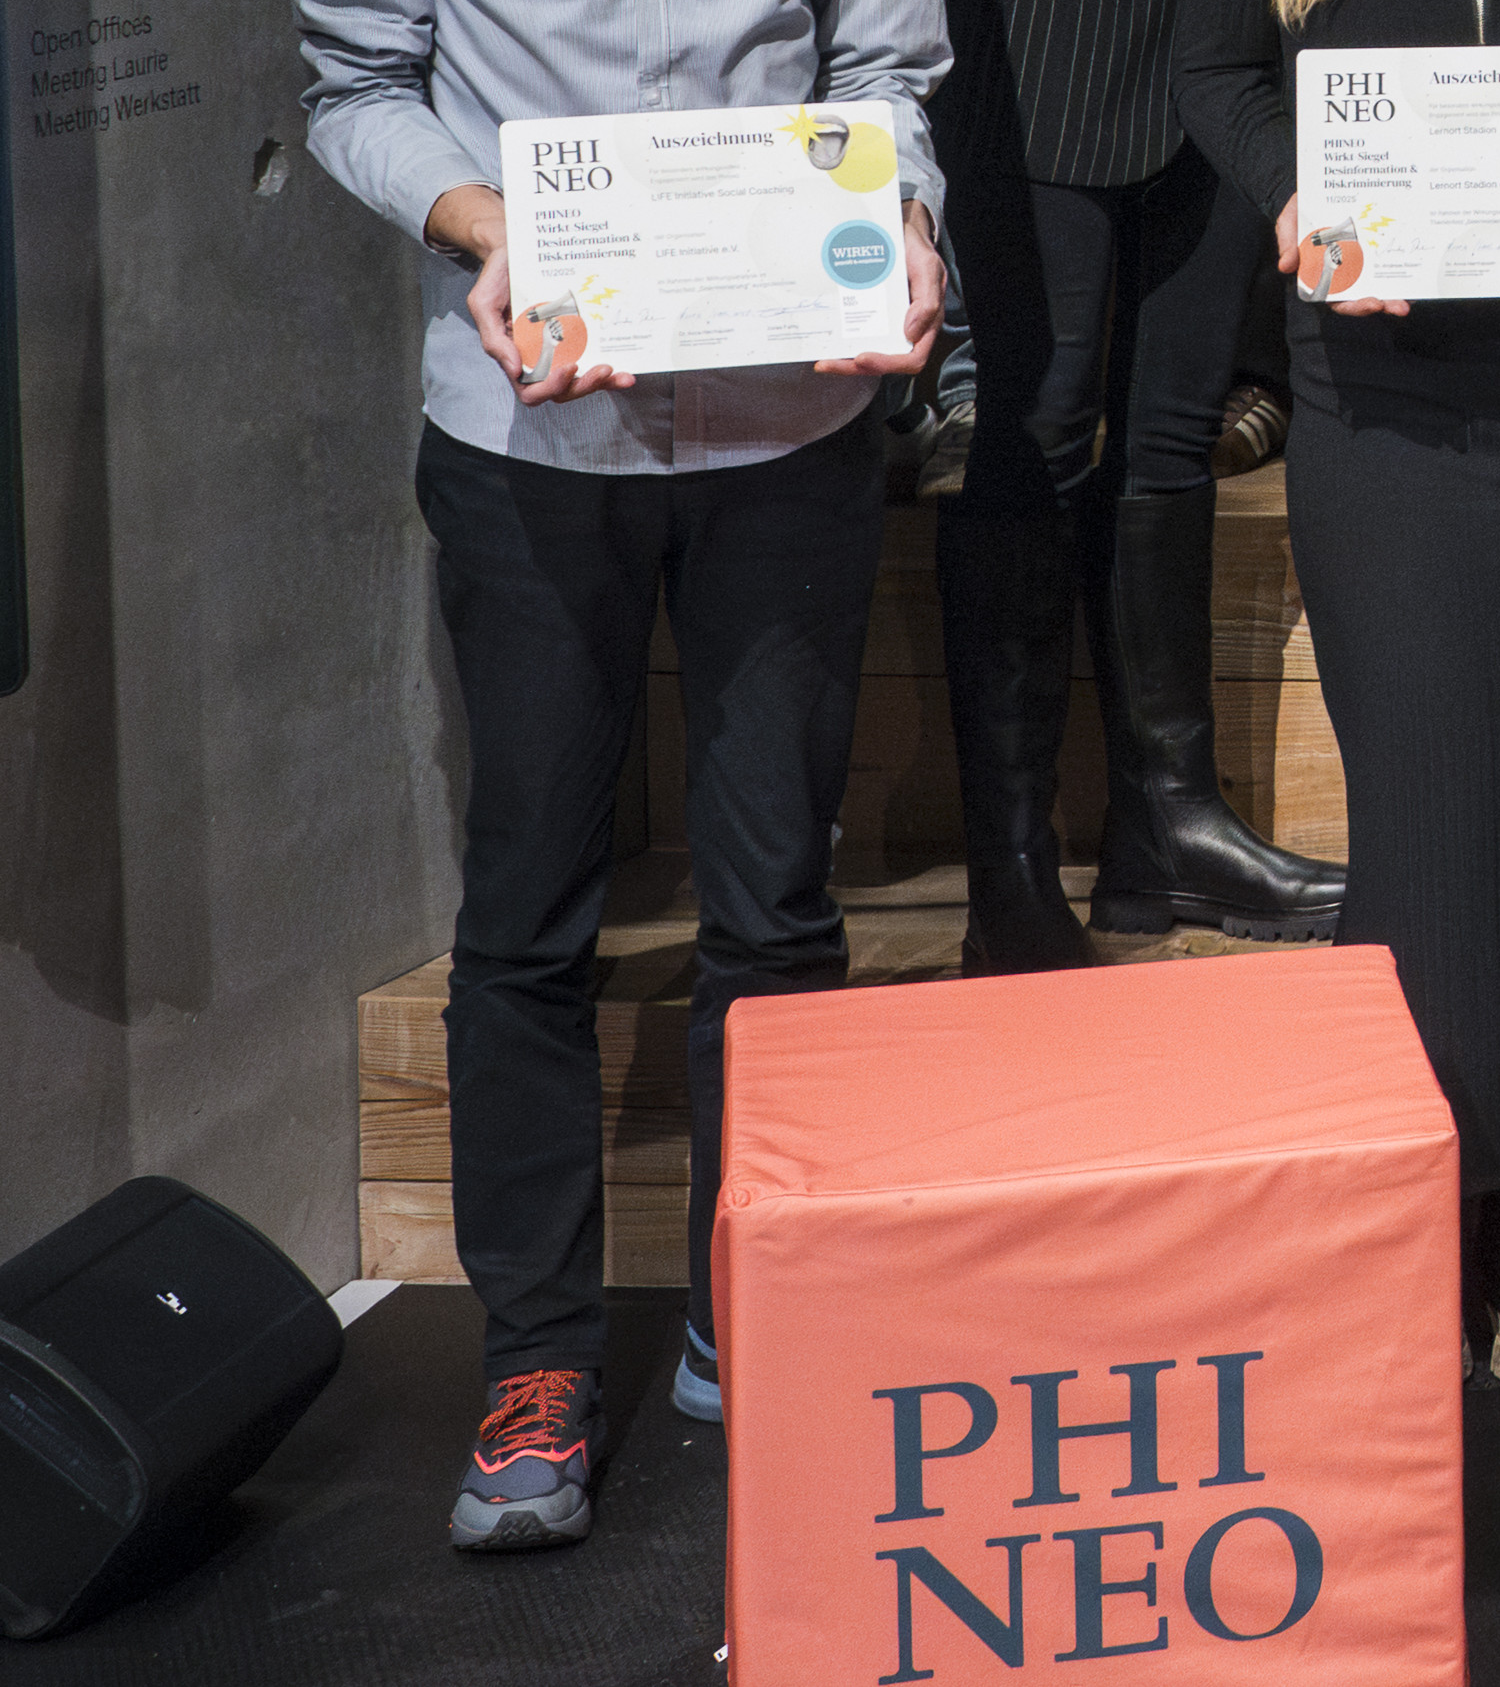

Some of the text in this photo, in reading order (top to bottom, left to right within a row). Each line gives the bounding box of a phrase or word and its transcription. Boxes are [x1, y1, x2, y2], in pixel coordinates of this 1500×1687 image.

[31, 16, 152, 59] Open Offices
[32, 50, 168, 97] Meeting Laurie
[1325, 72, 1384, 96] PHI
[35, 82, 201, 137] Meeting Werkstatt
[1325, 98, 1395, 122] NEO
[649, 131, 773, 149] Auszeichnung
[1428, 125, 1497, 135] Lernort Stadion
[531, 139, 599, 166] PHI
[533, 166, 612, 193] NEO
[831, 244, 884, 259] WIRKT!
[871, 1350, 1266, 1524] PHI
[875, 1506, 1324, 1686] NEO
